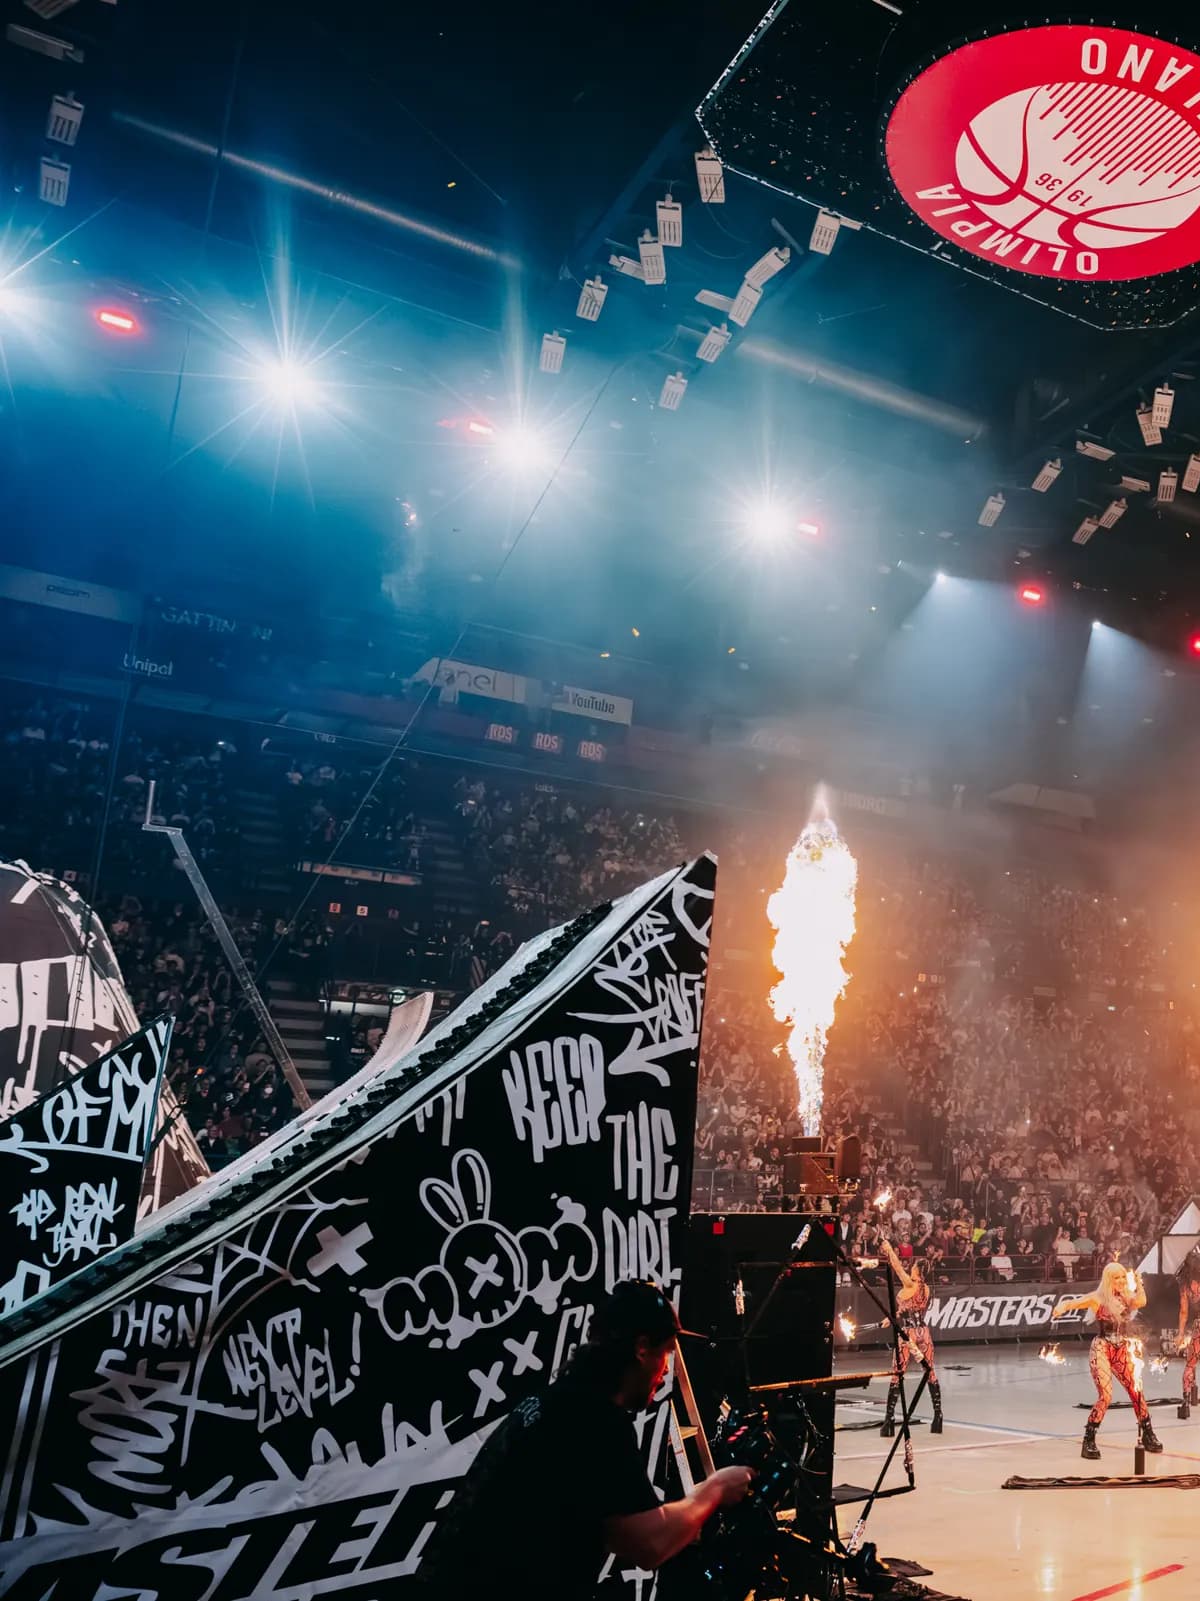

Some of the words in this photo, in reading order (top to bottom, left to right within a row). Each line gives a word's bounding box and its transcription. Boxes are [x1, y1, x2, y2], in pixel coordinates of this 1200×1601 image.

[916, 183, 1099, 275] OLIMPIA
[123, 653, 173, 677] Unipol
[571, 688, 616, 714] YouTube
[502, 1033, 606, 1163] KEEP
[606, 1101, 679, 1205] THE
[110, 1298, 203, 1348] THEN
[924, 1295, 1056, 1329] MASTERS
